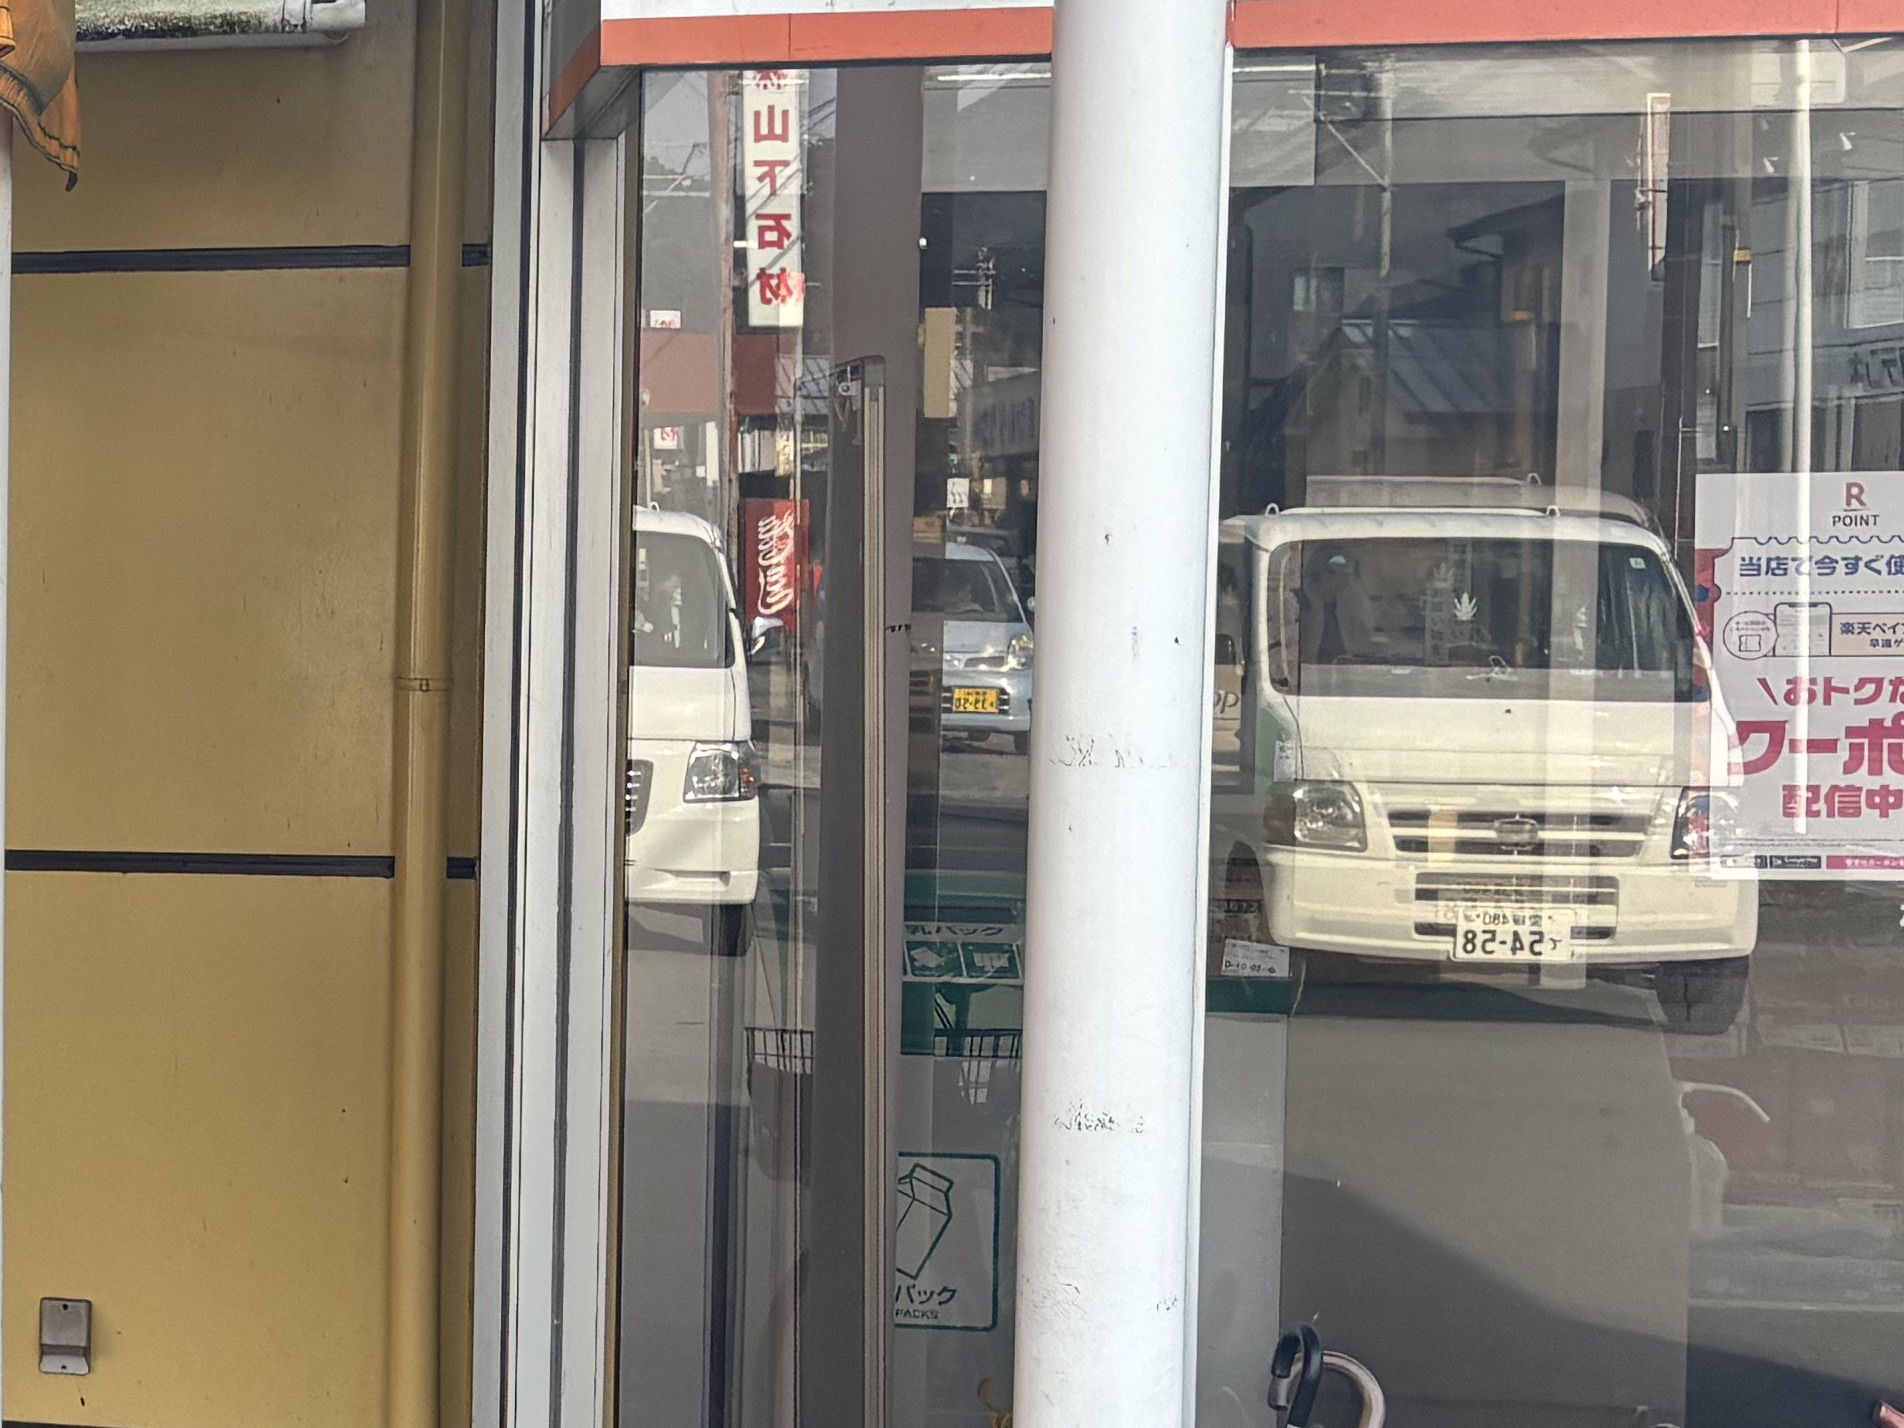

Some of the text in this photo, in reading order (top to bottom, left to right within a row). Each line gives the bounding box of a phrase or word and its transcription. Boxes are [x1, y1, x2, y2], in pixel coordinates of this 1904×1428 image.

[1845, 482, 1867, 507] R
[1832, 515, 1880, 527] POINT
[1840, 622, 1904, 635] 楽天ペイ
[1782, 784, 1904, 818] 配信中
[905, 924, 1003, 936] 乳パック
